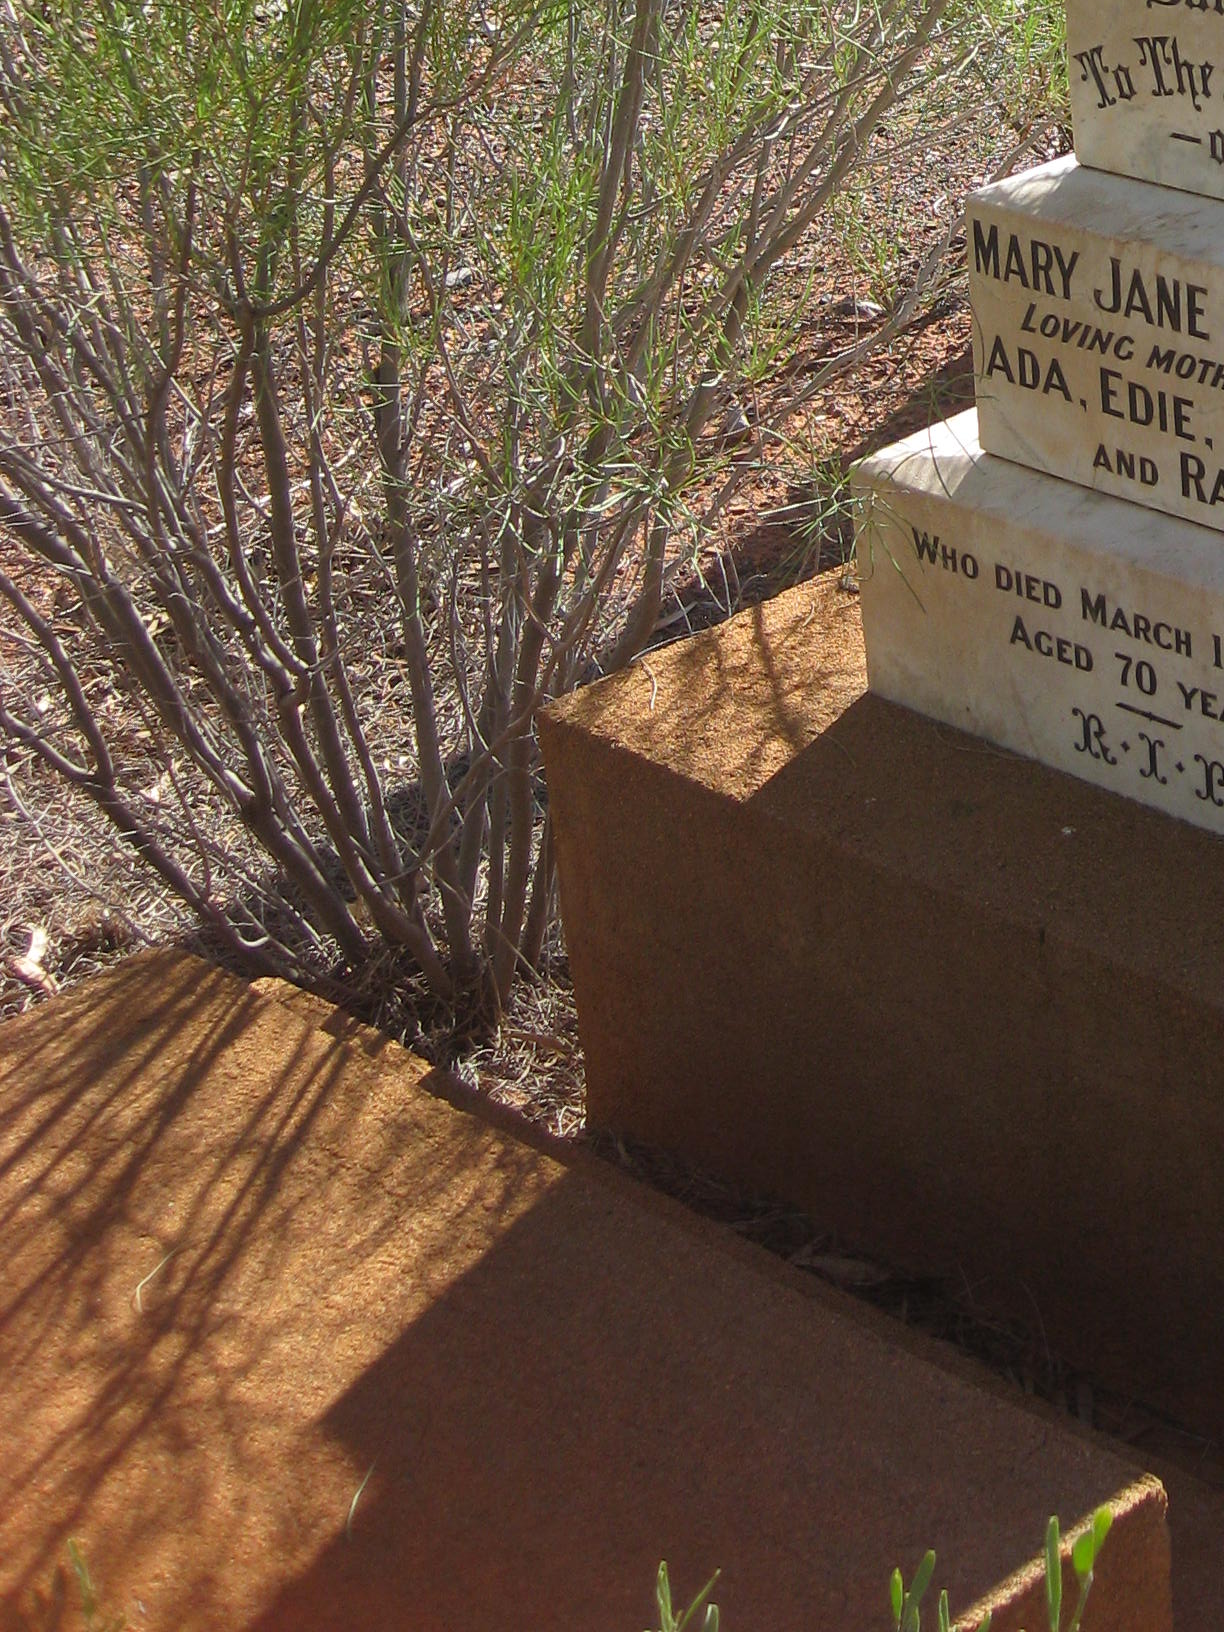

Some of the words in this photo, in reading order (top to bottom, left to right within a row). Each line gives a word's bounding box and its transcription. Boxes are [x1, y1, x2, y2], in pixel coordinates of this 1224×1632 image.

[1073, 45, 1138, 109] To
[1133, 36, 1214, 112] The
[972, 219, 1080, 301] MARY
[1094, 256, 1210, 341] JANE
[1020, 302, 1135, 361] LOVING
[986, 335, 1089, 413] ADA,
[1100, 367, 1214, 452] EDIE,
[1093, 443, 1159, 487] AND
[911, 526, 979, 580] WHO
[993, 563, 1063, 610] DIED
[1080, 587, 1193, 658] MARCH
[1009, 615, 1094, 672] AGED
[1114, 652, 1159, 696] 70
